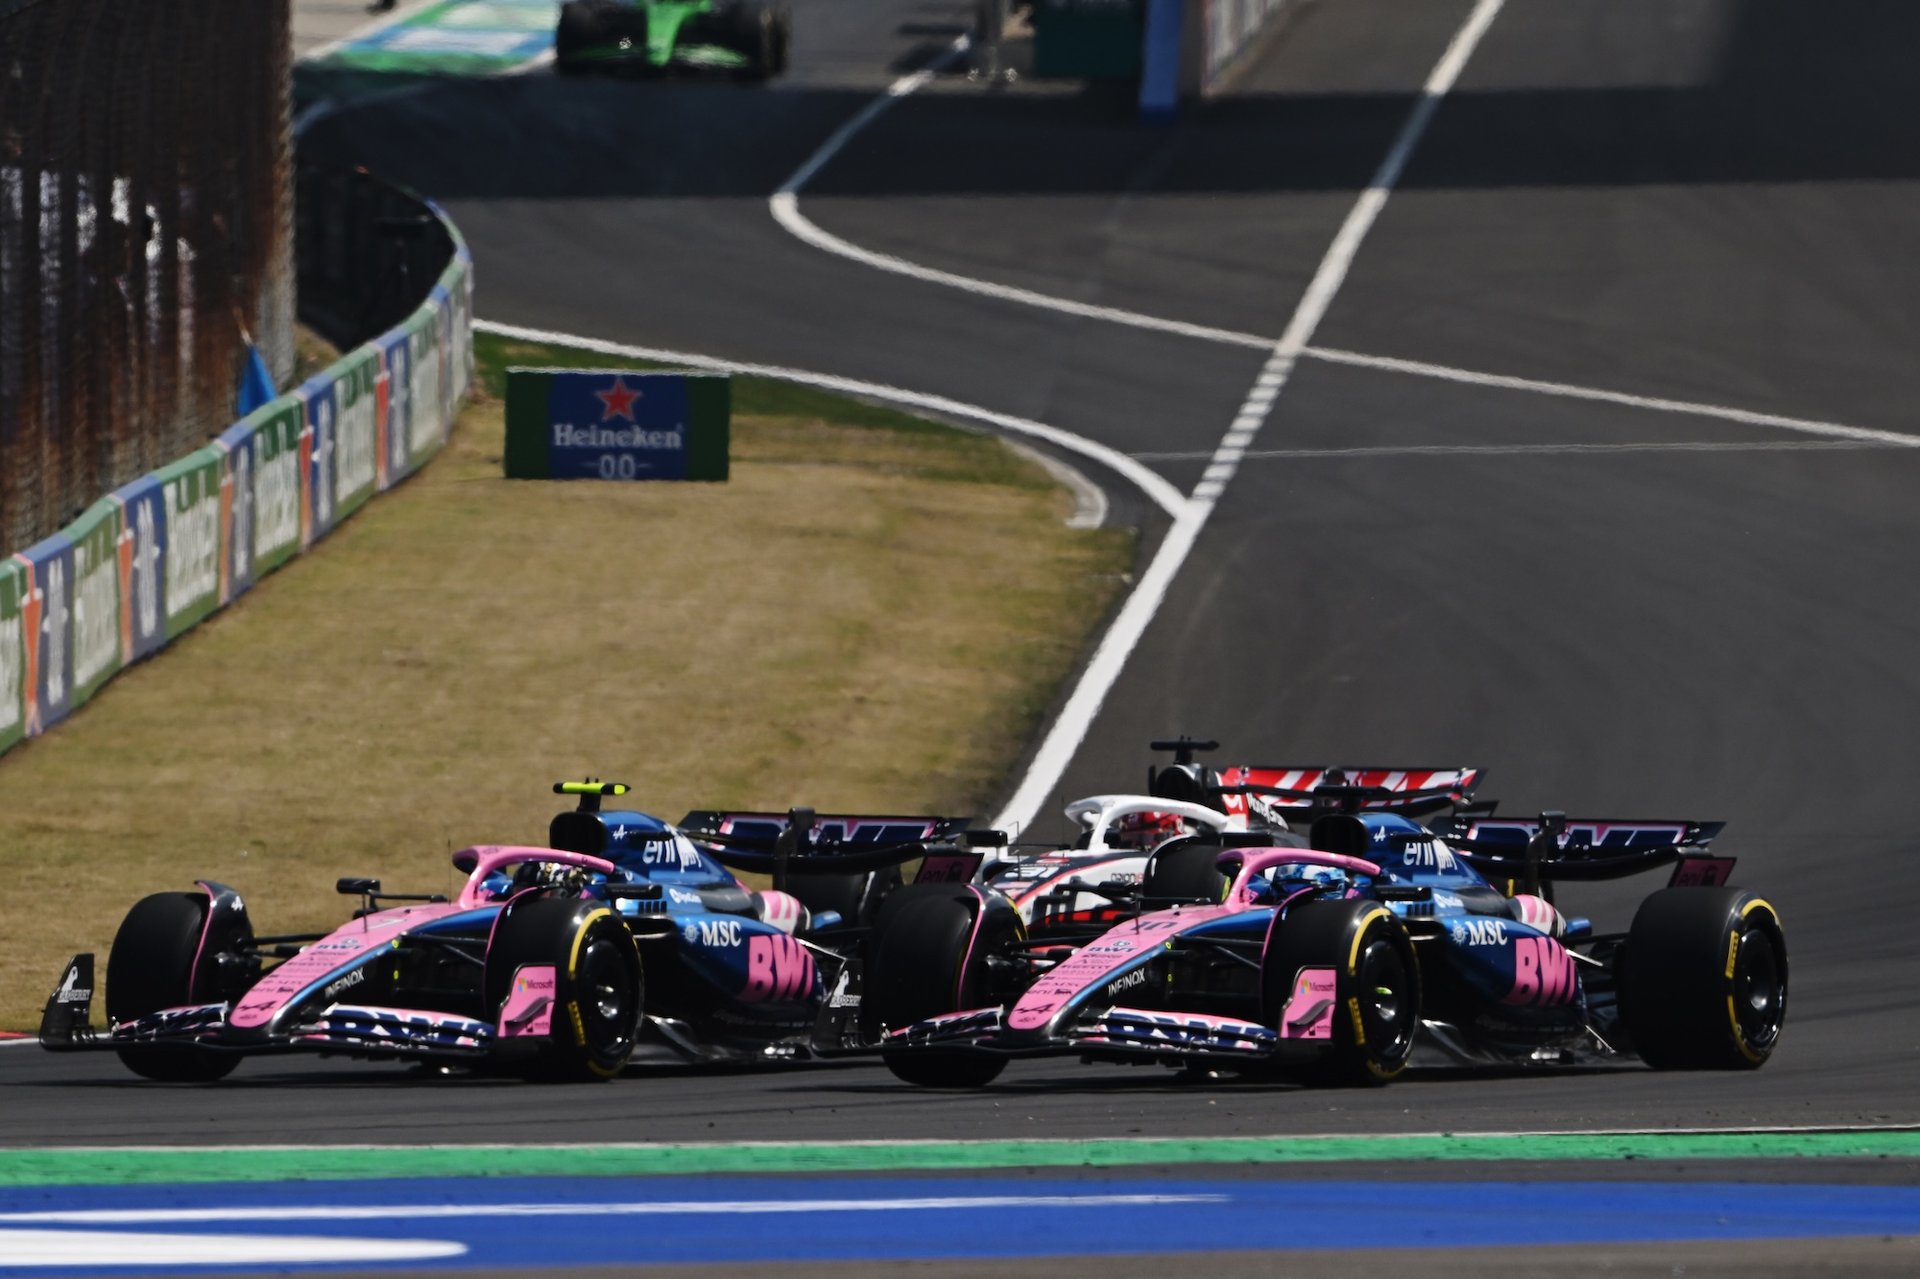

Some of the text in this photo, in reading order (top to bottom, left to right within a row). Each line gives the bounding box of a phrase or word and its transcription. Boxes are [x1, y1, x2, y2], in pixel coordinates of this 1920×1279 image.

[553, 424, 682, 449] Heineken
[699, 920, 742, 947] MSC
[1465, 920, 1508, 946] MSC
[1108, 967, 1146, 998] INFINOX
